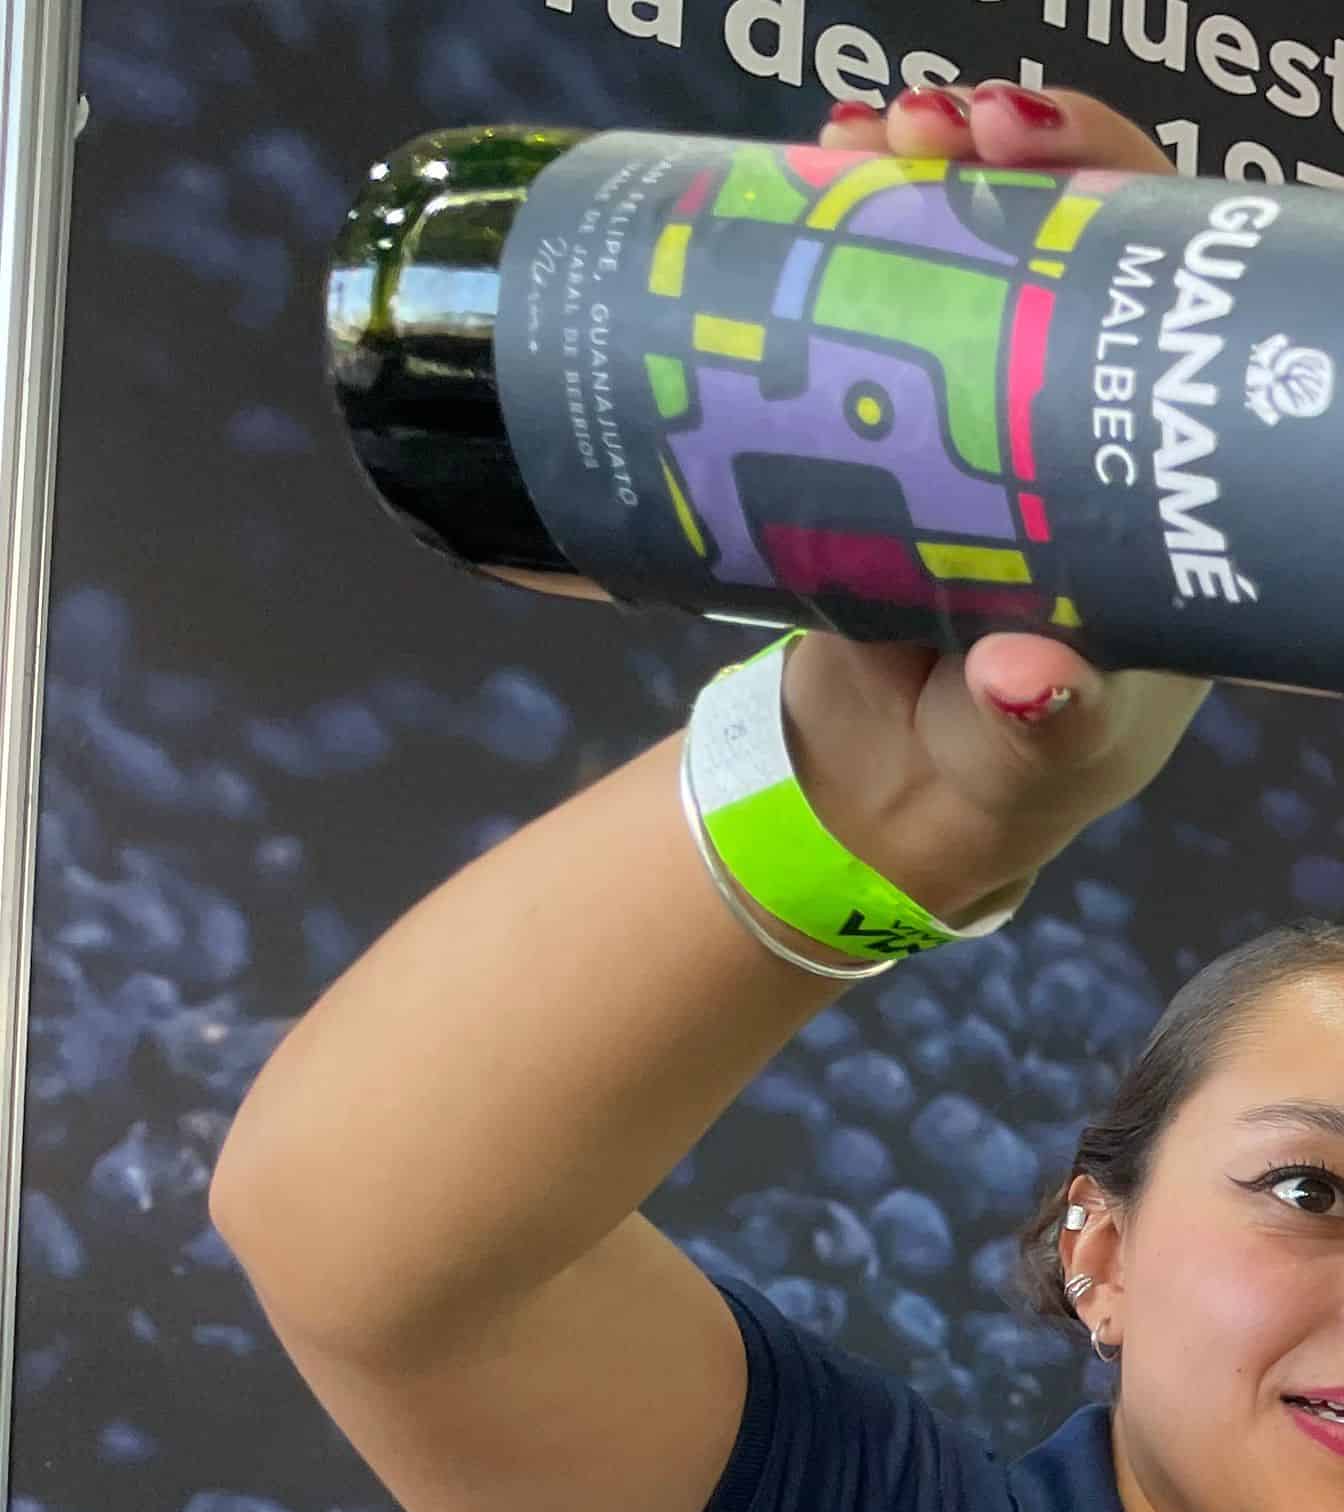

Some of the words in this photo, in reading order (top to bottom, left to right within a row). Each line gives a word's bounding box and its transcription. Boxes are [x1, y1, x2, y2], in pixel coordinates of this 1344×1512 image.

[589, 303, 639, 508] GUANAJUATO
[1093, 244, 1166, 488] MALBEC
[1152, 196, 1281, 603] GUANAMÉ
